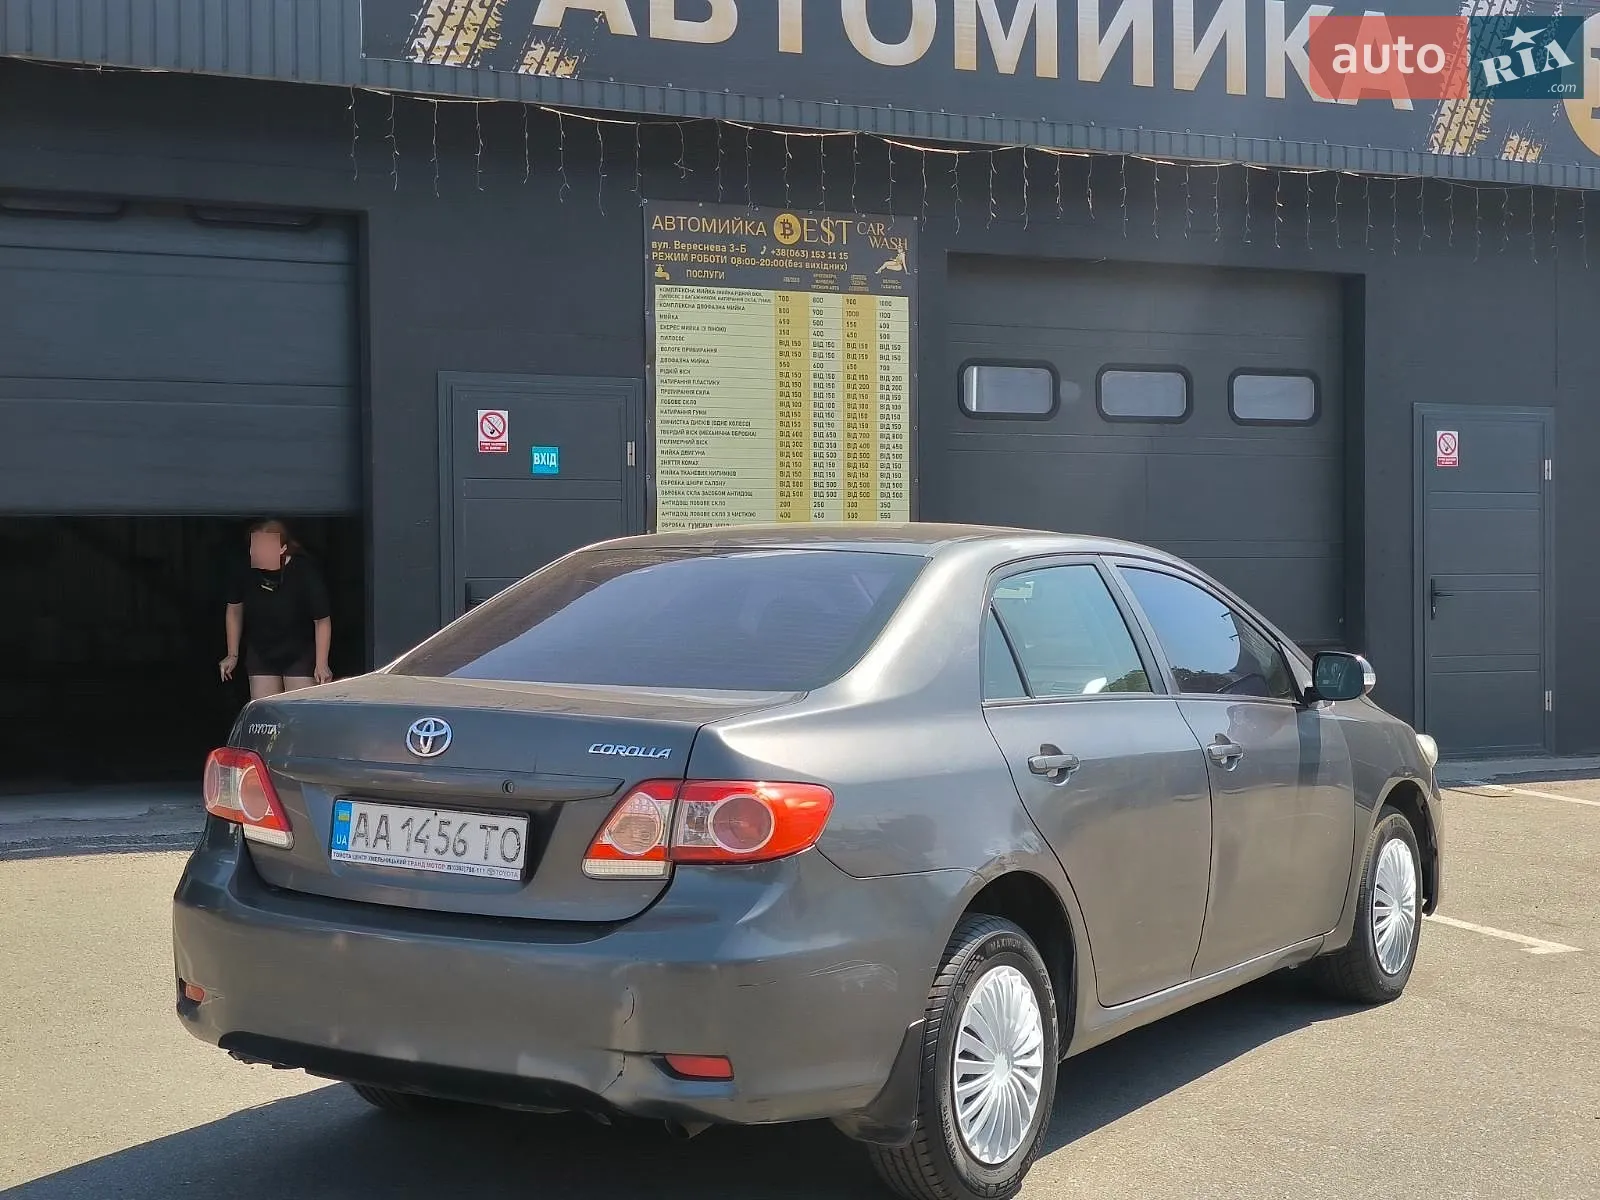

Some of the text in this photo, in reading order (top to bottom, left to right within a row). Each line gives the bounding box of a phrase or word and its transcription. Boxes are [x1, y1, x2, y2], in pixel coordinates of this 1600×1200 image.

[652, 215, 767, 237] АВТОМИЙКА
[856, 221, 886, 236] CAR
[651, 240, 747, 254] вул. Вереснева 3-Б
[868, 234, 909, 251] WASH
[770, 248, 848, 260] +38(063) 153 11 15
[652, 252, 688, 262] РЕЖИМ
[691, 254, 727, 264] РОБОТИ
[806, 261, 848, 272] вихідних)
[686, 269, 725, 280] ПОСЛУГИ
[534, 452, 557, 467] ВХІД
[248, 723, 278, 735] TOYOTA
[588, 743, 672, 760] COROLLA
[336, 836, 348, 846] UA
[352, 812, 521, 863] AA 1456 TO
[496, 870, 519, 878] TOYOTA
